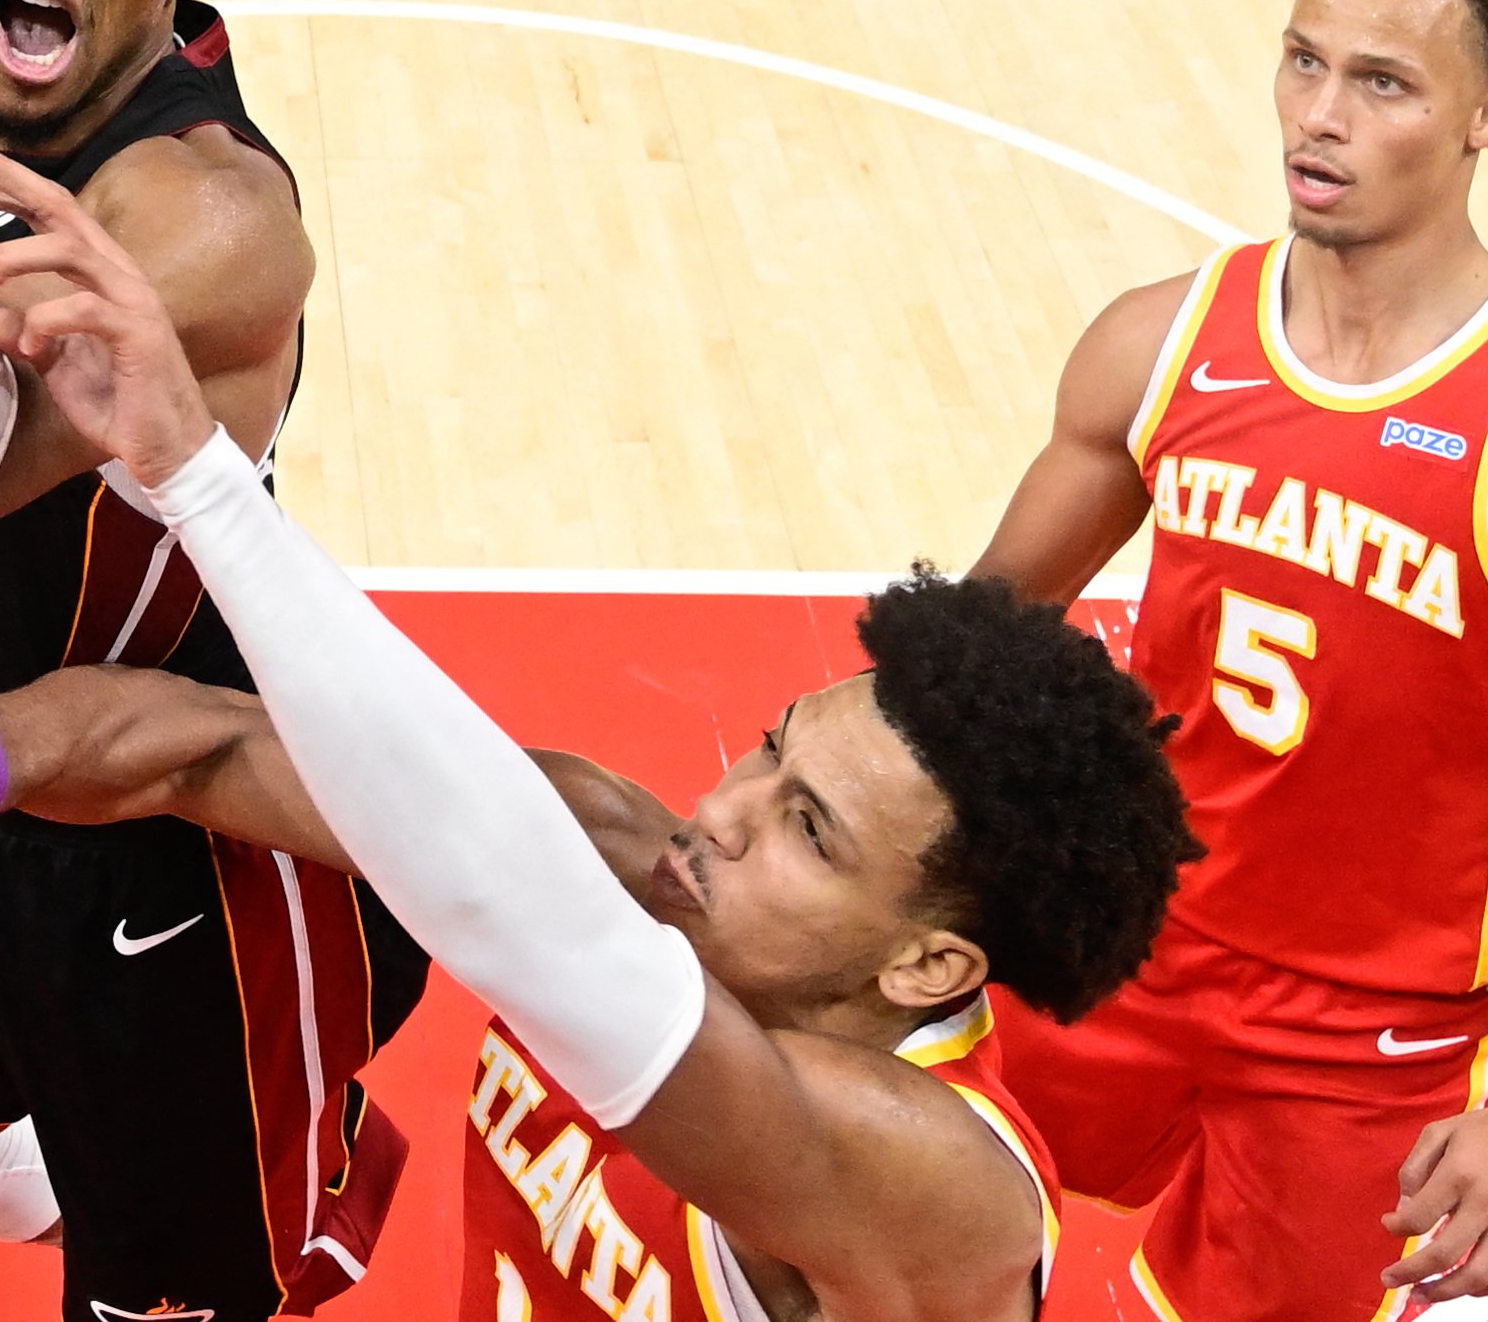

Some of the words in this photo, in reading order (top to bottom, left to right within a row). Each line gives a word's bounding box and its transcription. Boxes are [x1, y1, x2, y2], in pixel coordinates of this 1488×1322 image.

[1381, 418, 1466, 459] paze
[1153, 455, 1464, 639] ATLANTA
[1212, 587, 1317, 757] 5
